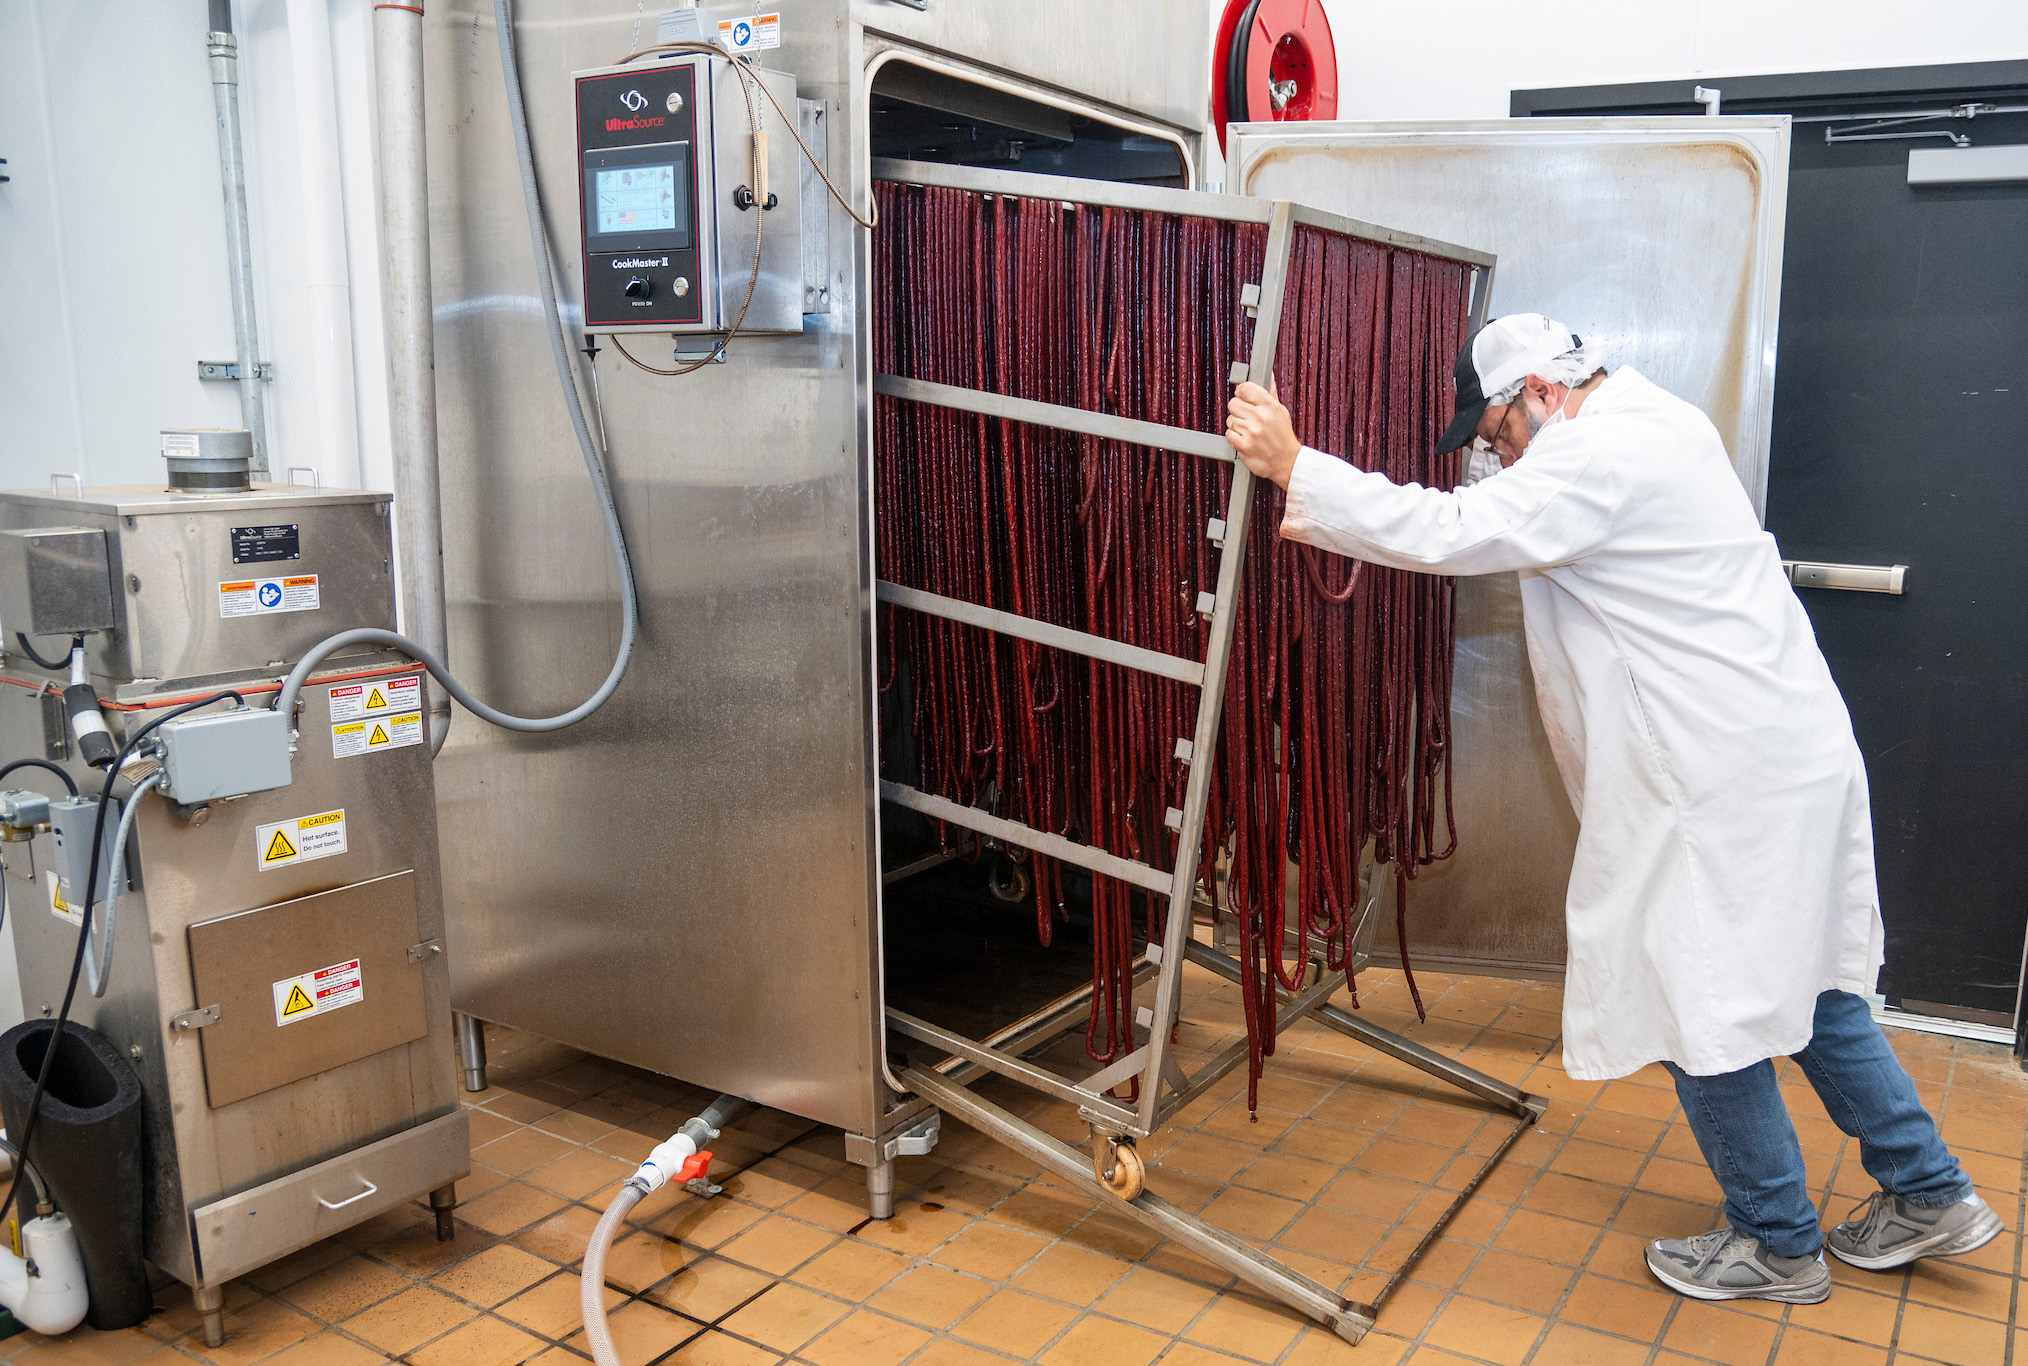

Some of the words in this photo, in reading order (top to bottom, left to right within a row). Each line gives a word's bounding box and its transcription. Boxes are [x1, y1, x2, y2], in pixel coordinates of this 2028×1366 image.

[605, 115, 664, 132] UltraSource
[612, 257, 660, 269] CookMaster
[394, 679, 418, 688] DANGER
[337, 687, 362, 696] DANGER
[397, 715, 419, 724] CAUTION
[341, 725, 364, 733] ATTENTION
[308, 813, 341, 826] CAUTION
[315, 829, 340, 839] surface.
[313, 842, 323, 850] not
[323, 839, 342, 848] touch.
[327, 963, 352, 976] DANGER
[329, 982, 354, 995] DANGER
